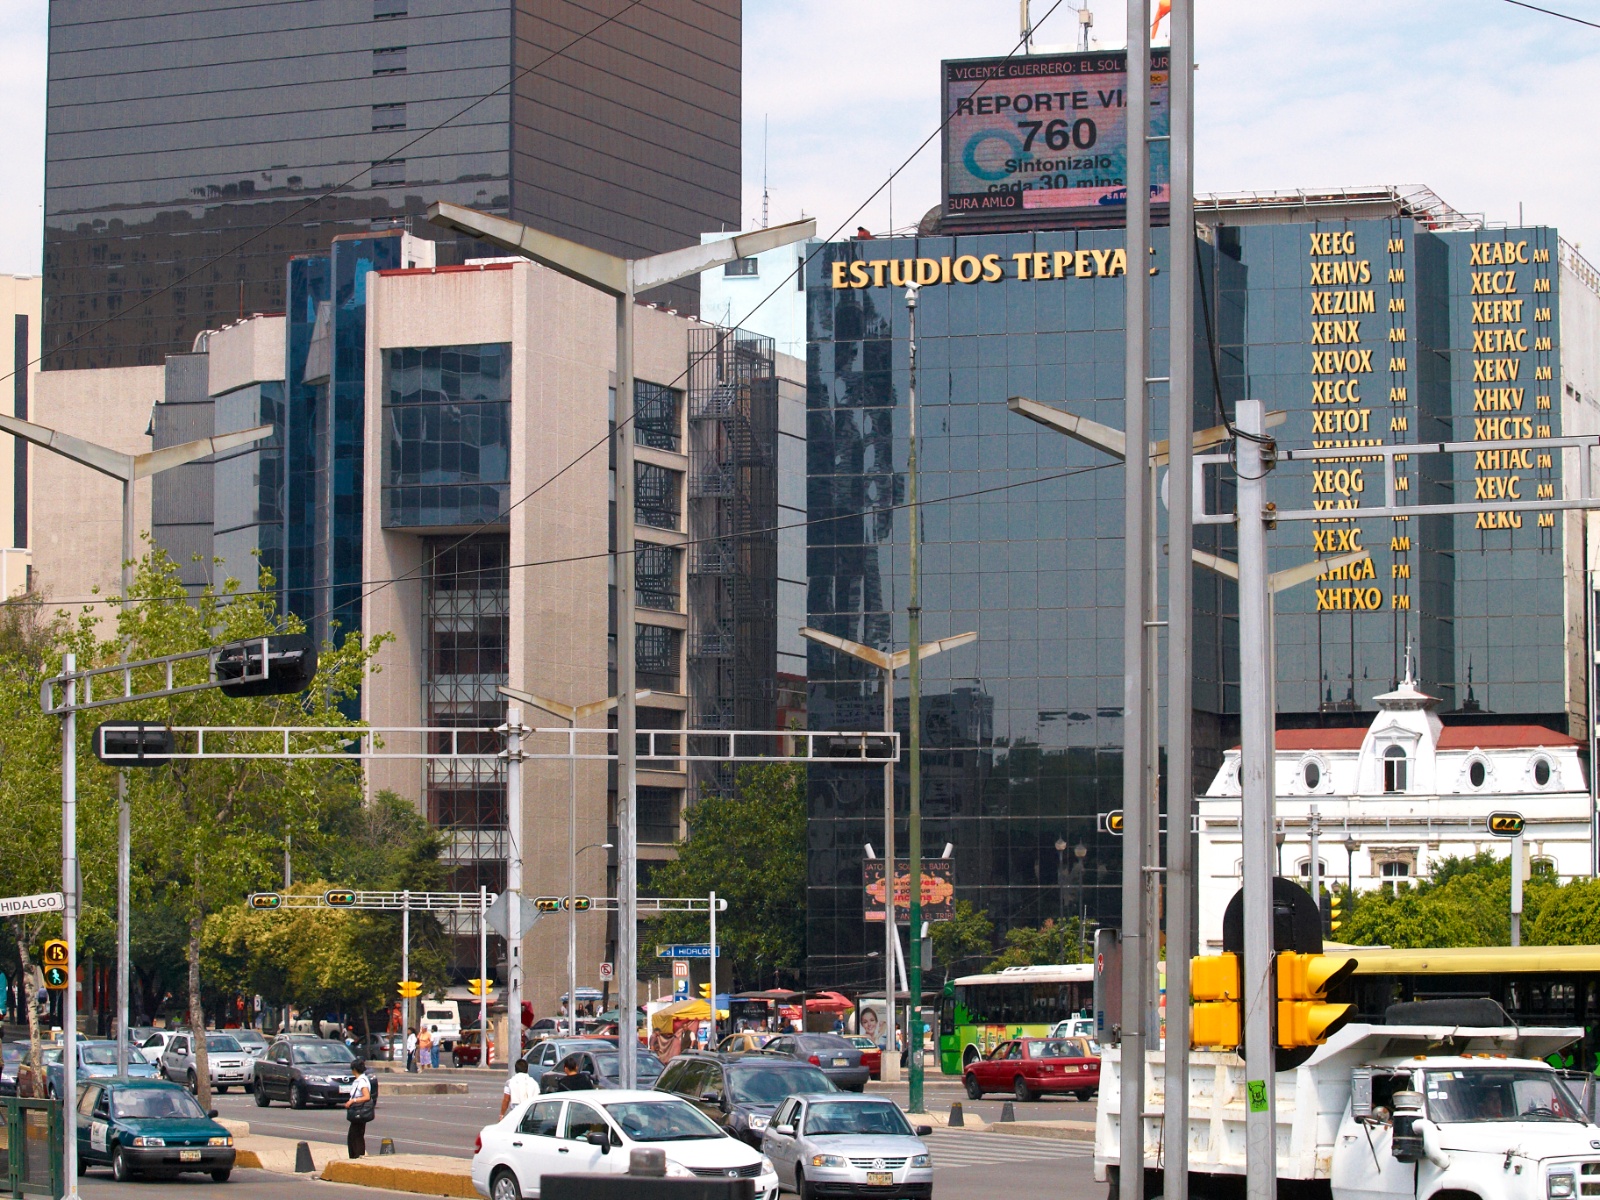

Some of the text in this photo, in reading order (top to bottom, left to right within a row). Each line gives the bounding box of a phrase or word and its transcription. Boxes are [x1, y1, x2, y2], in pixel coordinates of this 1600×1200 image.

[955, 66, 1005, 79] VICENTE
[1009, 61, 1077, 75] GUERRERO:
[1080, 60, 1094, 72] EL
[1097, 57, 1121, 71] SOL
[956, 91, 1088, 116] REPORTE
[1017, 117, 1097, 152] 760
[1004, 155, 1112, 173] Sintonizalo
[988, 179, 1032, 194] cada
[1040, 174, 1068, 190] 30
[1106, 190, 1156, 200] SAMG
[982, 195, 1015, 208] AMLO
[1310, 231, 1404, 255] XEEG AM
[1470, 240, 1549, 265] XEABC AM
[832, 247, 1156, 289] ESTUDIOS TEPEYA
[1311, 260, 1405, 285] XEMVS AM
[1471, 270, 1550, 295] XECZ AM
[1311, 290, 1405, 315] XEZUM AM
[1471, 299, 1551, 324] XEFRT AM
[1311, 320, 1406, 345] XENX AM
[1472, 328, 1551, 353] XETAC AM
[1311, 349, 1406, 374] XEVOX AM
[1473, 358, 1552, 382] XEKV AM
[1312, 379, 1407, 404] XECC AM
[1473, 387, 1551, 411] XHKV FM
[1312, 408, 1407, 433] XETOT AM
[1474, 416, 1551, 441] XHCTS FM
[1474, 448, 1552, 470] XHTAC FM
[1312, 468, 1364, 497] XEQG
[1475, 475, 1554, 499] XEVC AM
[1537, 513, 1554, 527] AM
[1312, 527, 1410, 553] XEXC AM
[1391, 564, 1410, 579] FM
[1315, 587, 1410, 611] XHTXO FM
[0, 897, 56, 911] HIDALGO
[53, 947, 63, 959] 15
